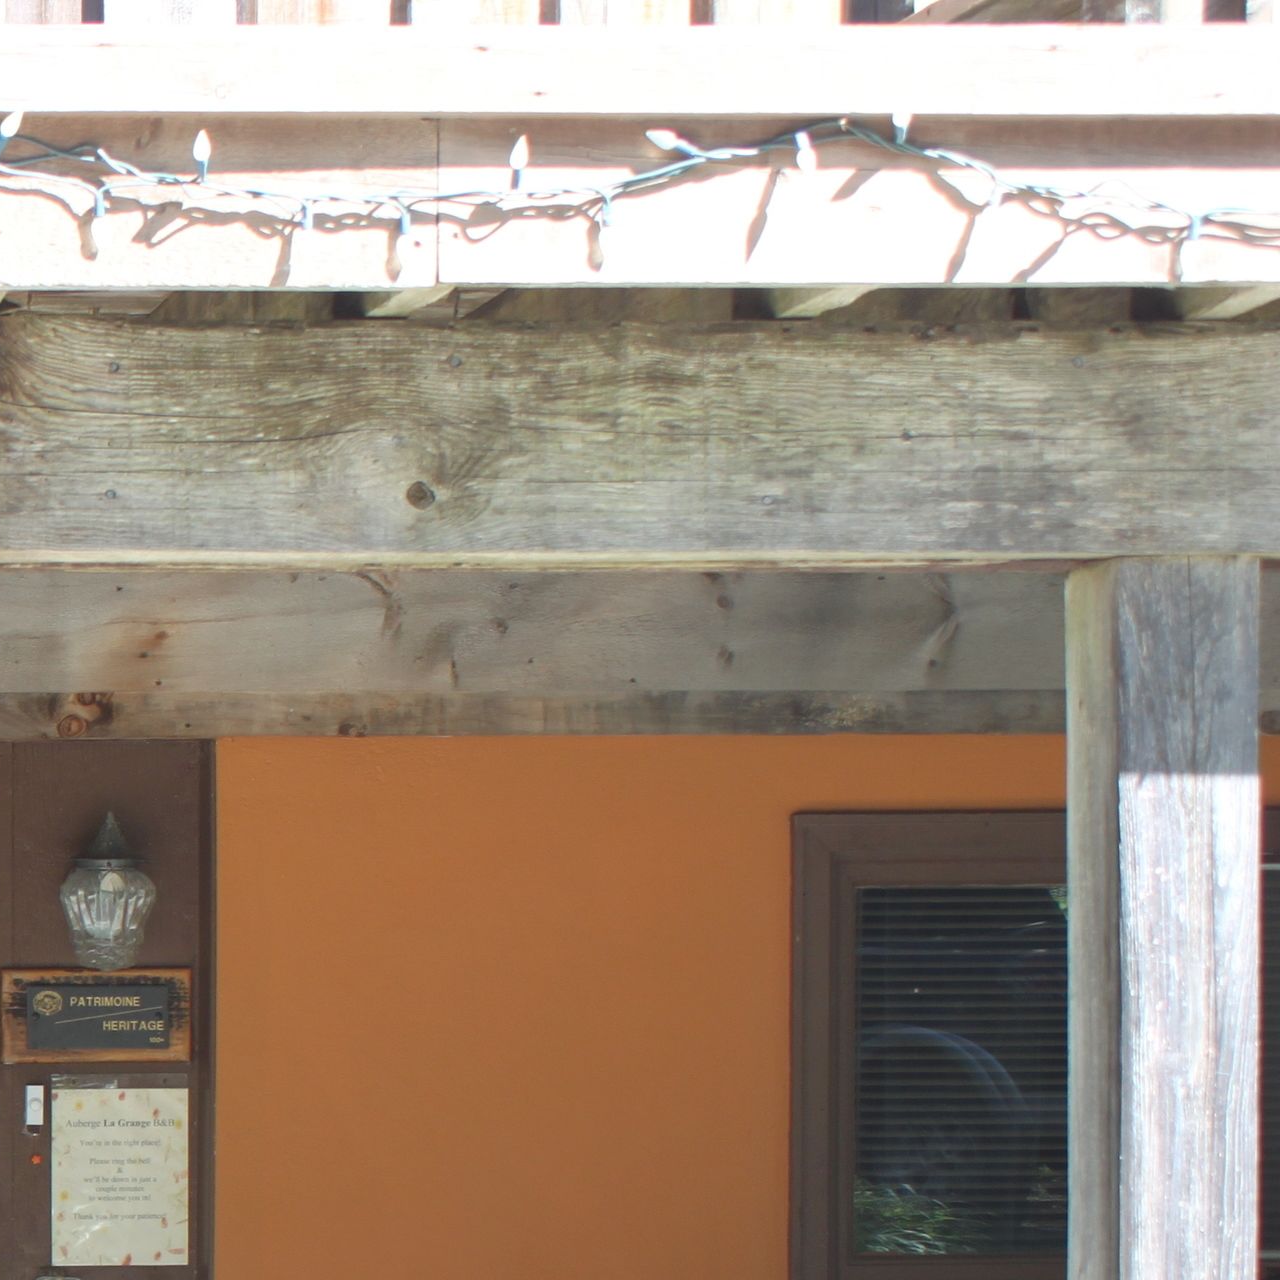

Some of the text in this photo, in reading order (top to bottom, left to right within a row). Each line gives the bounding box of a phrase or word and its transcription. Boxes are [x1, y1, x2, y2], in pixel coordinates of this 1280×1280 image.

[69, 996, 141, 1007] PATRIMOINE
[102, 1020, 165, 1031] HERITAGE
[65, 1119, 175, 1129] Auberge La Grange B&B
